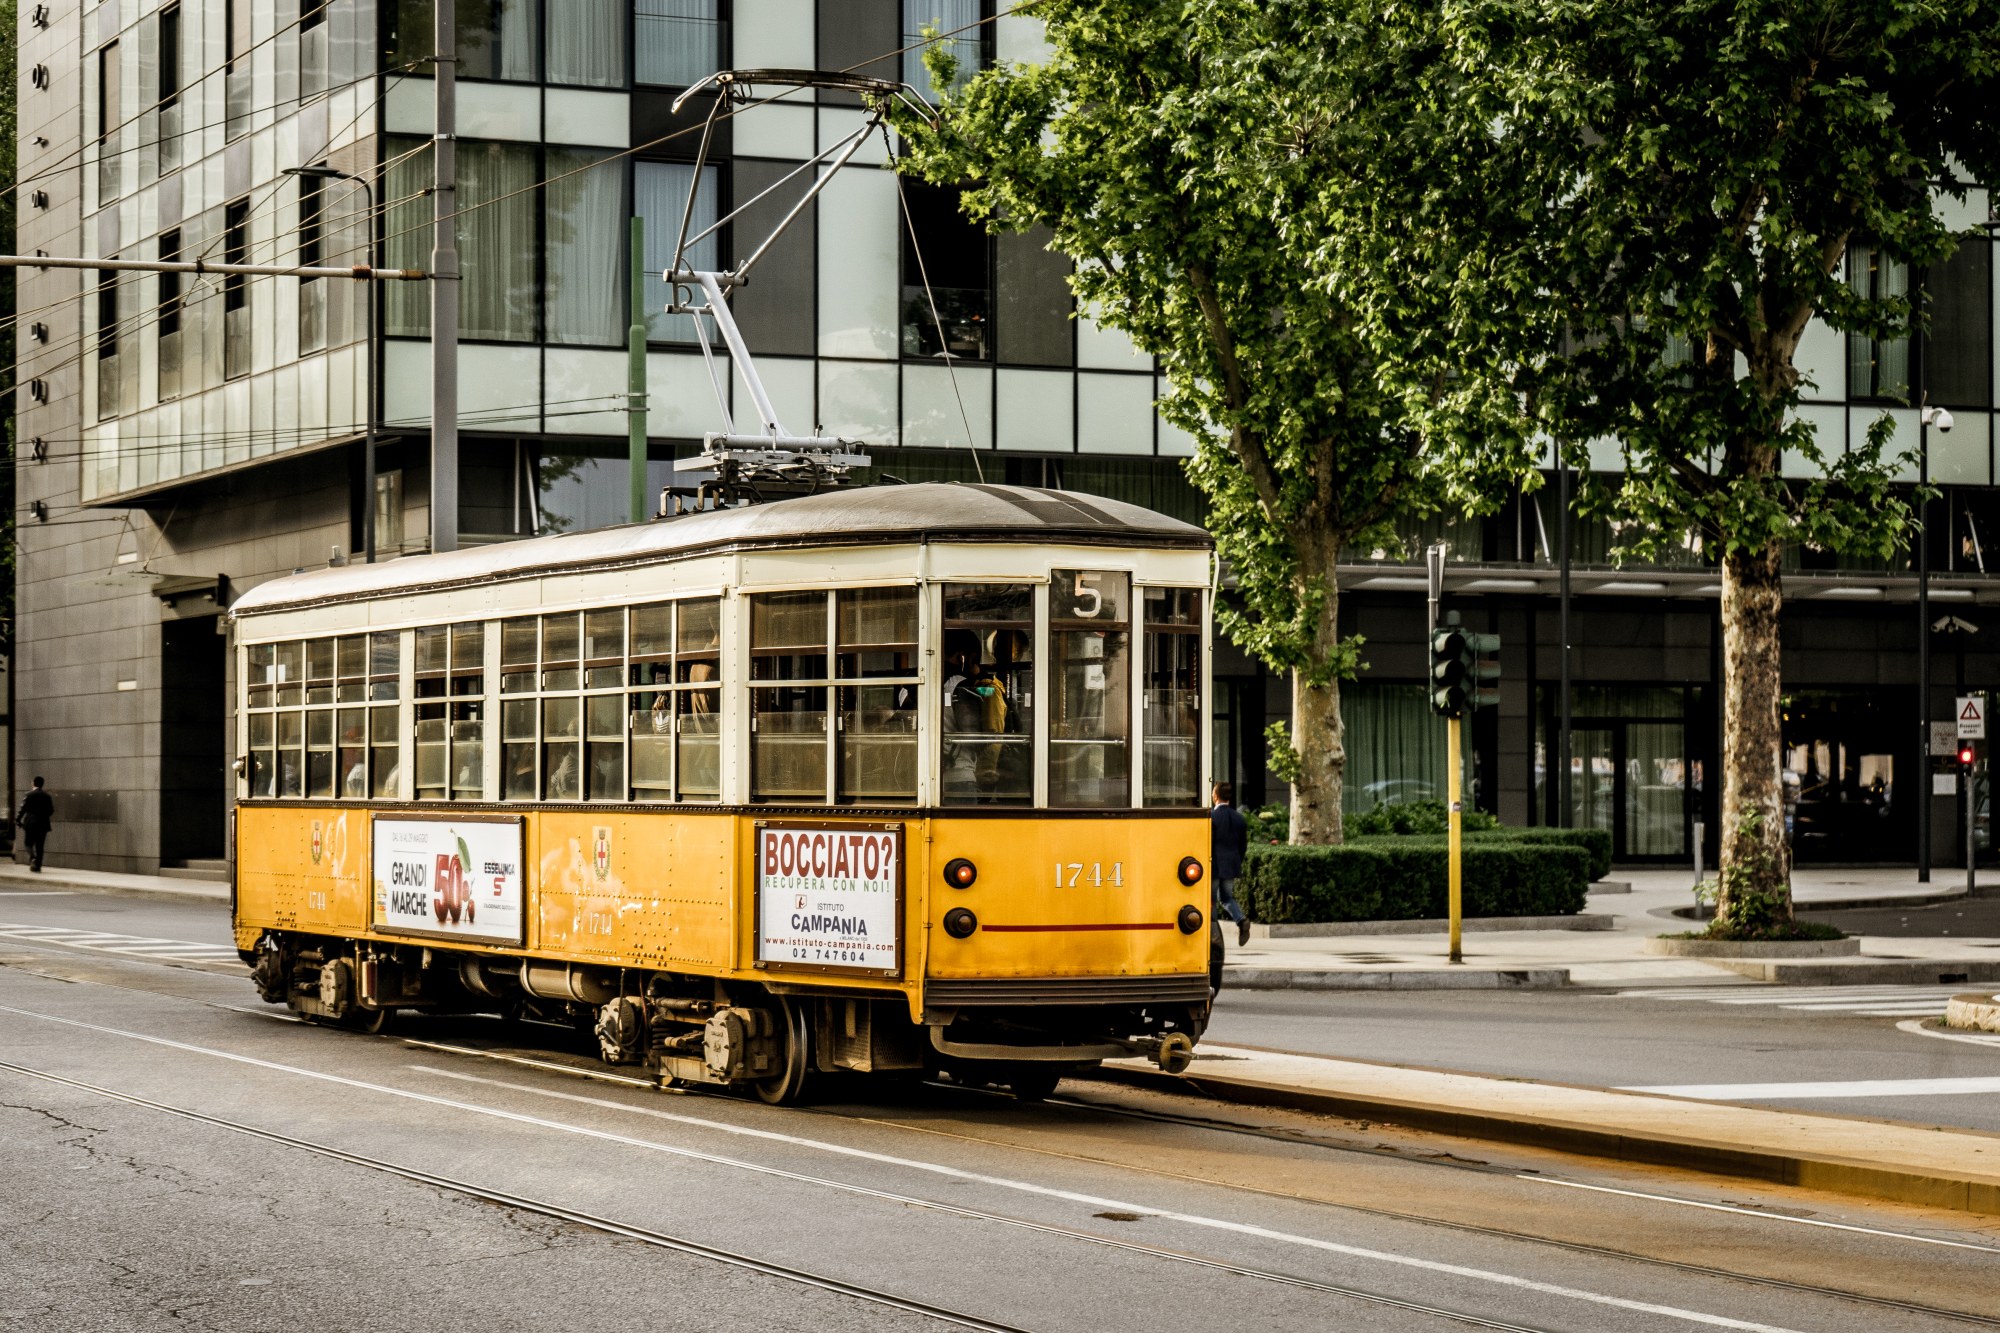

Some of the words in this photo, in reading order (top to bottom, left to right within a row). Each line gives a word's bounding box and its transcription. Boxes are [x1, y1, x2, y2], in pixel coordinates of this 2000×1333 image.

[1073, 573, 1102, 618] 5
[765, 832, 893, 881] BOCCIATO?
[391, 861, 427, 887] GRANDI
[765, 876, 825, 890] RECUPERA
[833, 878, 856, 891] CON
[863, 880, 890, 893] NOI!
[1055, 862, 1124, 888] 1744
[310, 892, 326, 911] 1744
[391, 891, 427, 916] MARCHE
[817, 903, 845, 912] ISTITUTO
[590, 912, 612, 935] 1744
[791, 913, 868, 936] CAMPANIA
[765, 936, 894, 952] www.istituto-campania.com
[792, 947, 807, 959] 02
[815, 949, 865, 962] 747604
